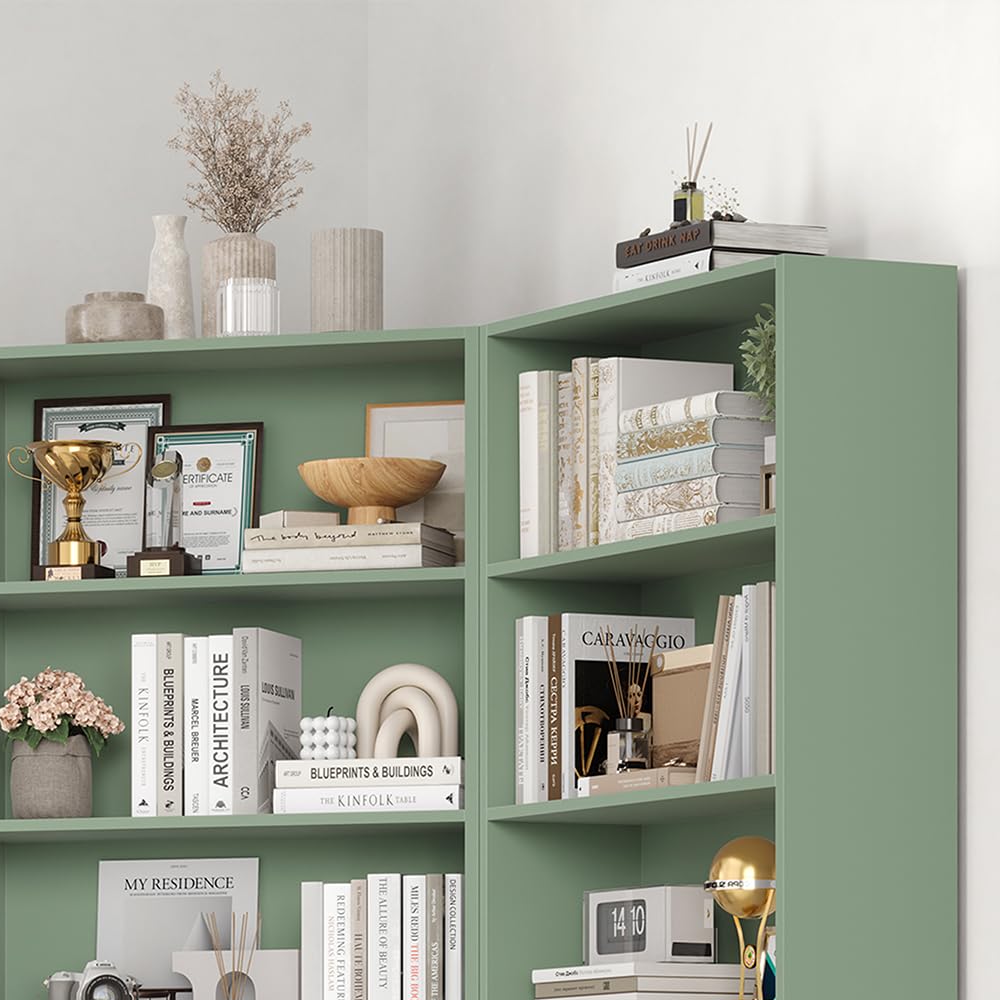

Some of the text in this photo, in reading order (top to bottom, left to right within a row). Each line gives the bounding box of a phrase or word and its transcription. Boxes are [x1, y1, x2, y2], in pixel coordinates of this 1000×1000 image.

[623, 229, 700, 258] EAT DRINK NAP
[251, 531, 357, 543] The body beyond
[582, 631, 686, 649] CARAVAGGIO
[163, 668, 175, 728] BLUEPRINTS
[261, 681, 295, 700] LOUIS SULLIVAN
[137, 687, 150, 744] KINFOLK
[213, 653, 229, 788] ARCHITECTURE
[240, 685, 250, 730] LOUIS SULLIVAN
[550, 676, 558, 765] СЕСТРА КЕРРИ
[191, 698, 199, 763] MARCEL BREUER
[163, 741, 175, 792] BUILDINGS
[310, 765, 434, 779] BLUEPRINTS & BUILDINGS
[338, 793, 395, 808] KINFOLK
[124, 876, 235, 890] MY RESIDENCE
[410, 886, 419, 914] MILES
[336, 895, 345, 956] REDEEMING
[378, 879, 388, 989] THE ALLURE OF BEAUTY
[410, 916, 419, 942] REDD
[612, 905, 645, 937] 14 10
[354, 933, 363, 966] HAUTE
[410, 945, 419, 963] THE
[410, 965, 419, 982] BIG
